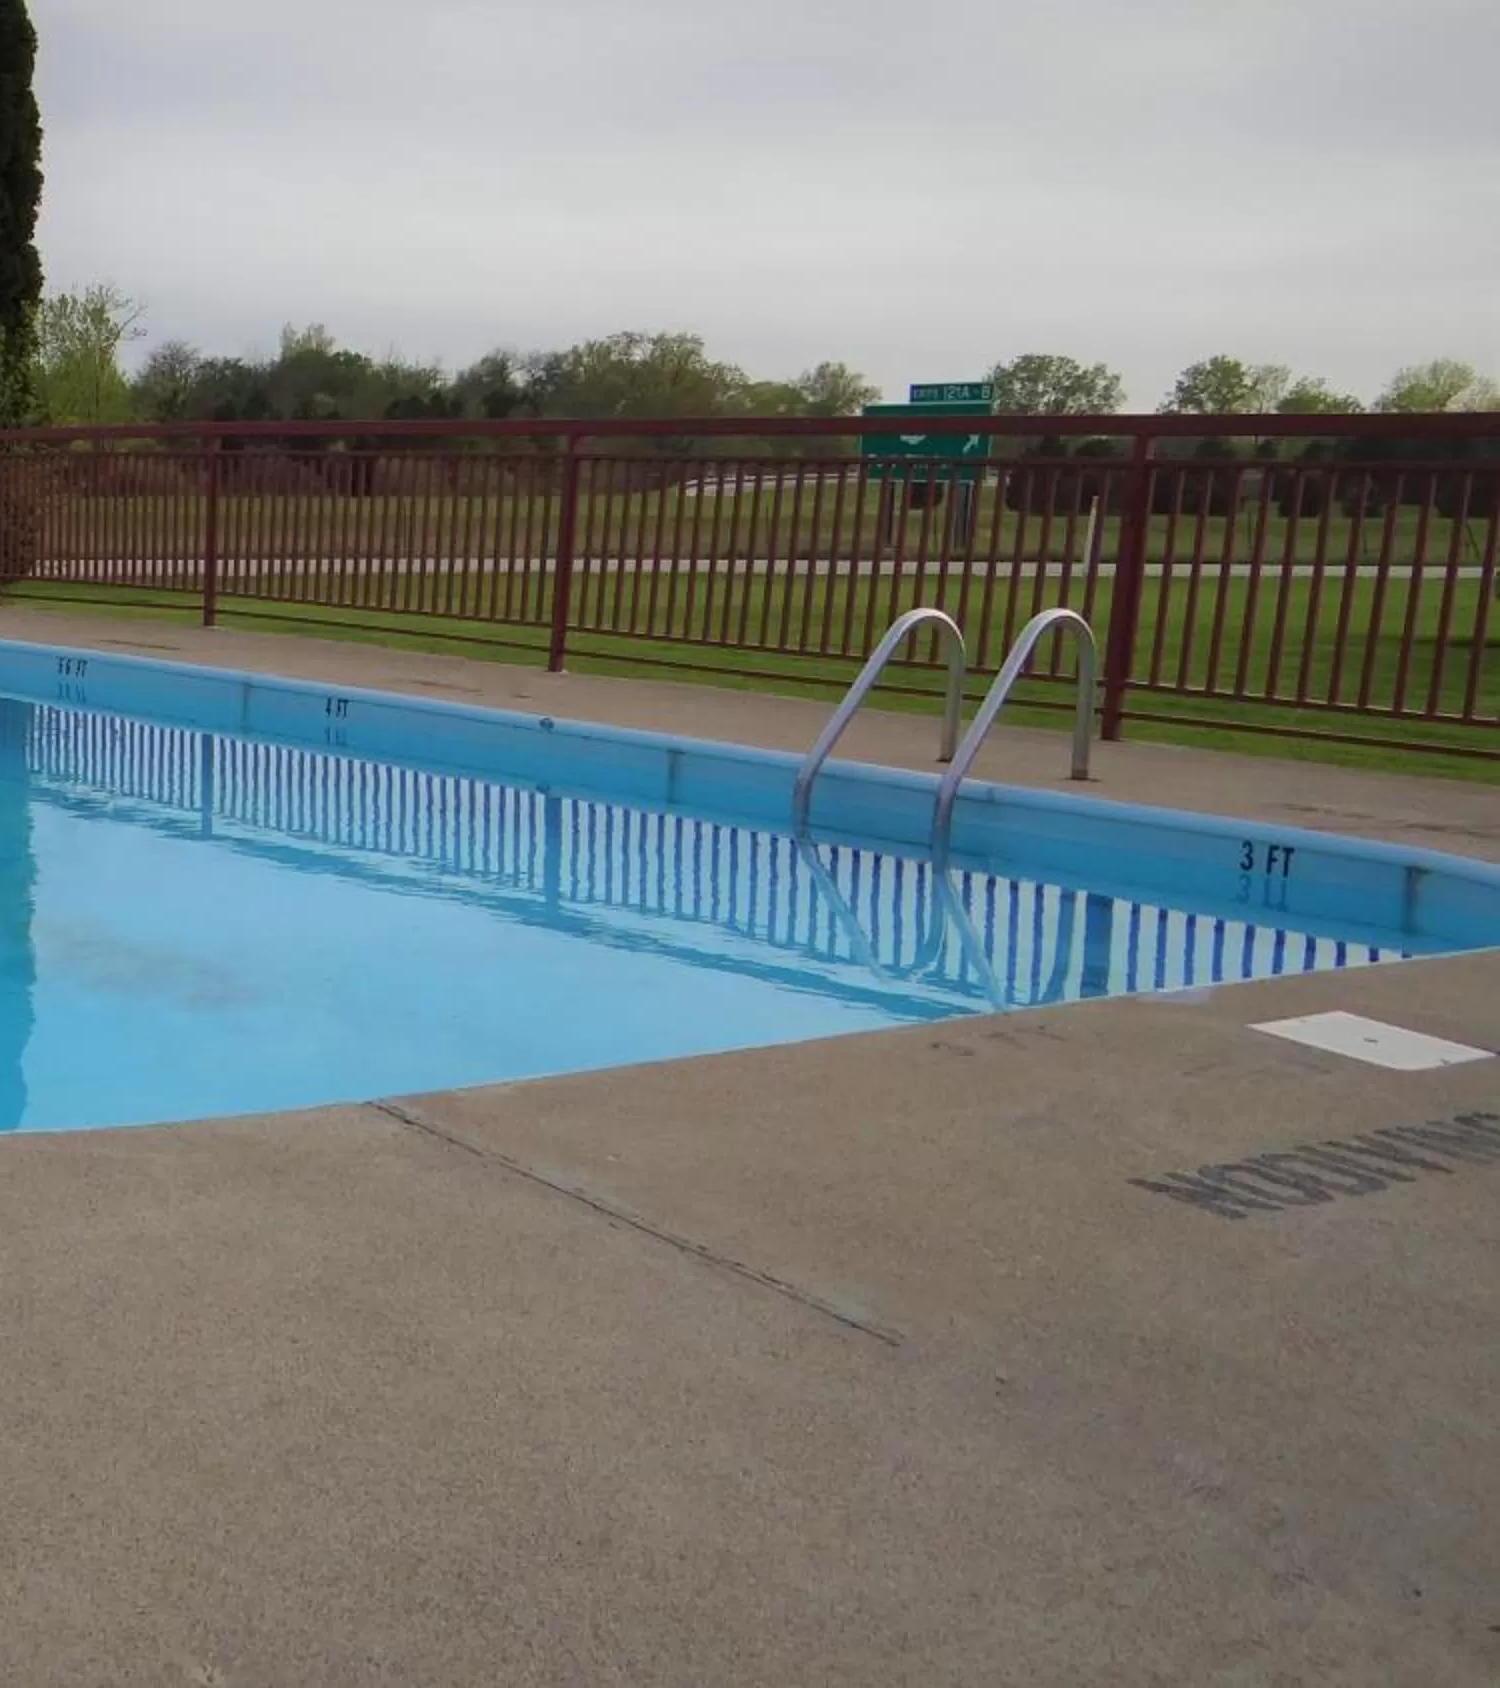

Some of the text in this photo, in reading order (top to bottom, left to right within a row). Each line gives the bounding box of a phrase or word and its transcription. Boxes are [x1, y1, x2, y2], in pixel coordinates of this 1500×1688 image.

[335, 697, 350, 719] FT
[1240, 840, 1295, 878] 3 FT
